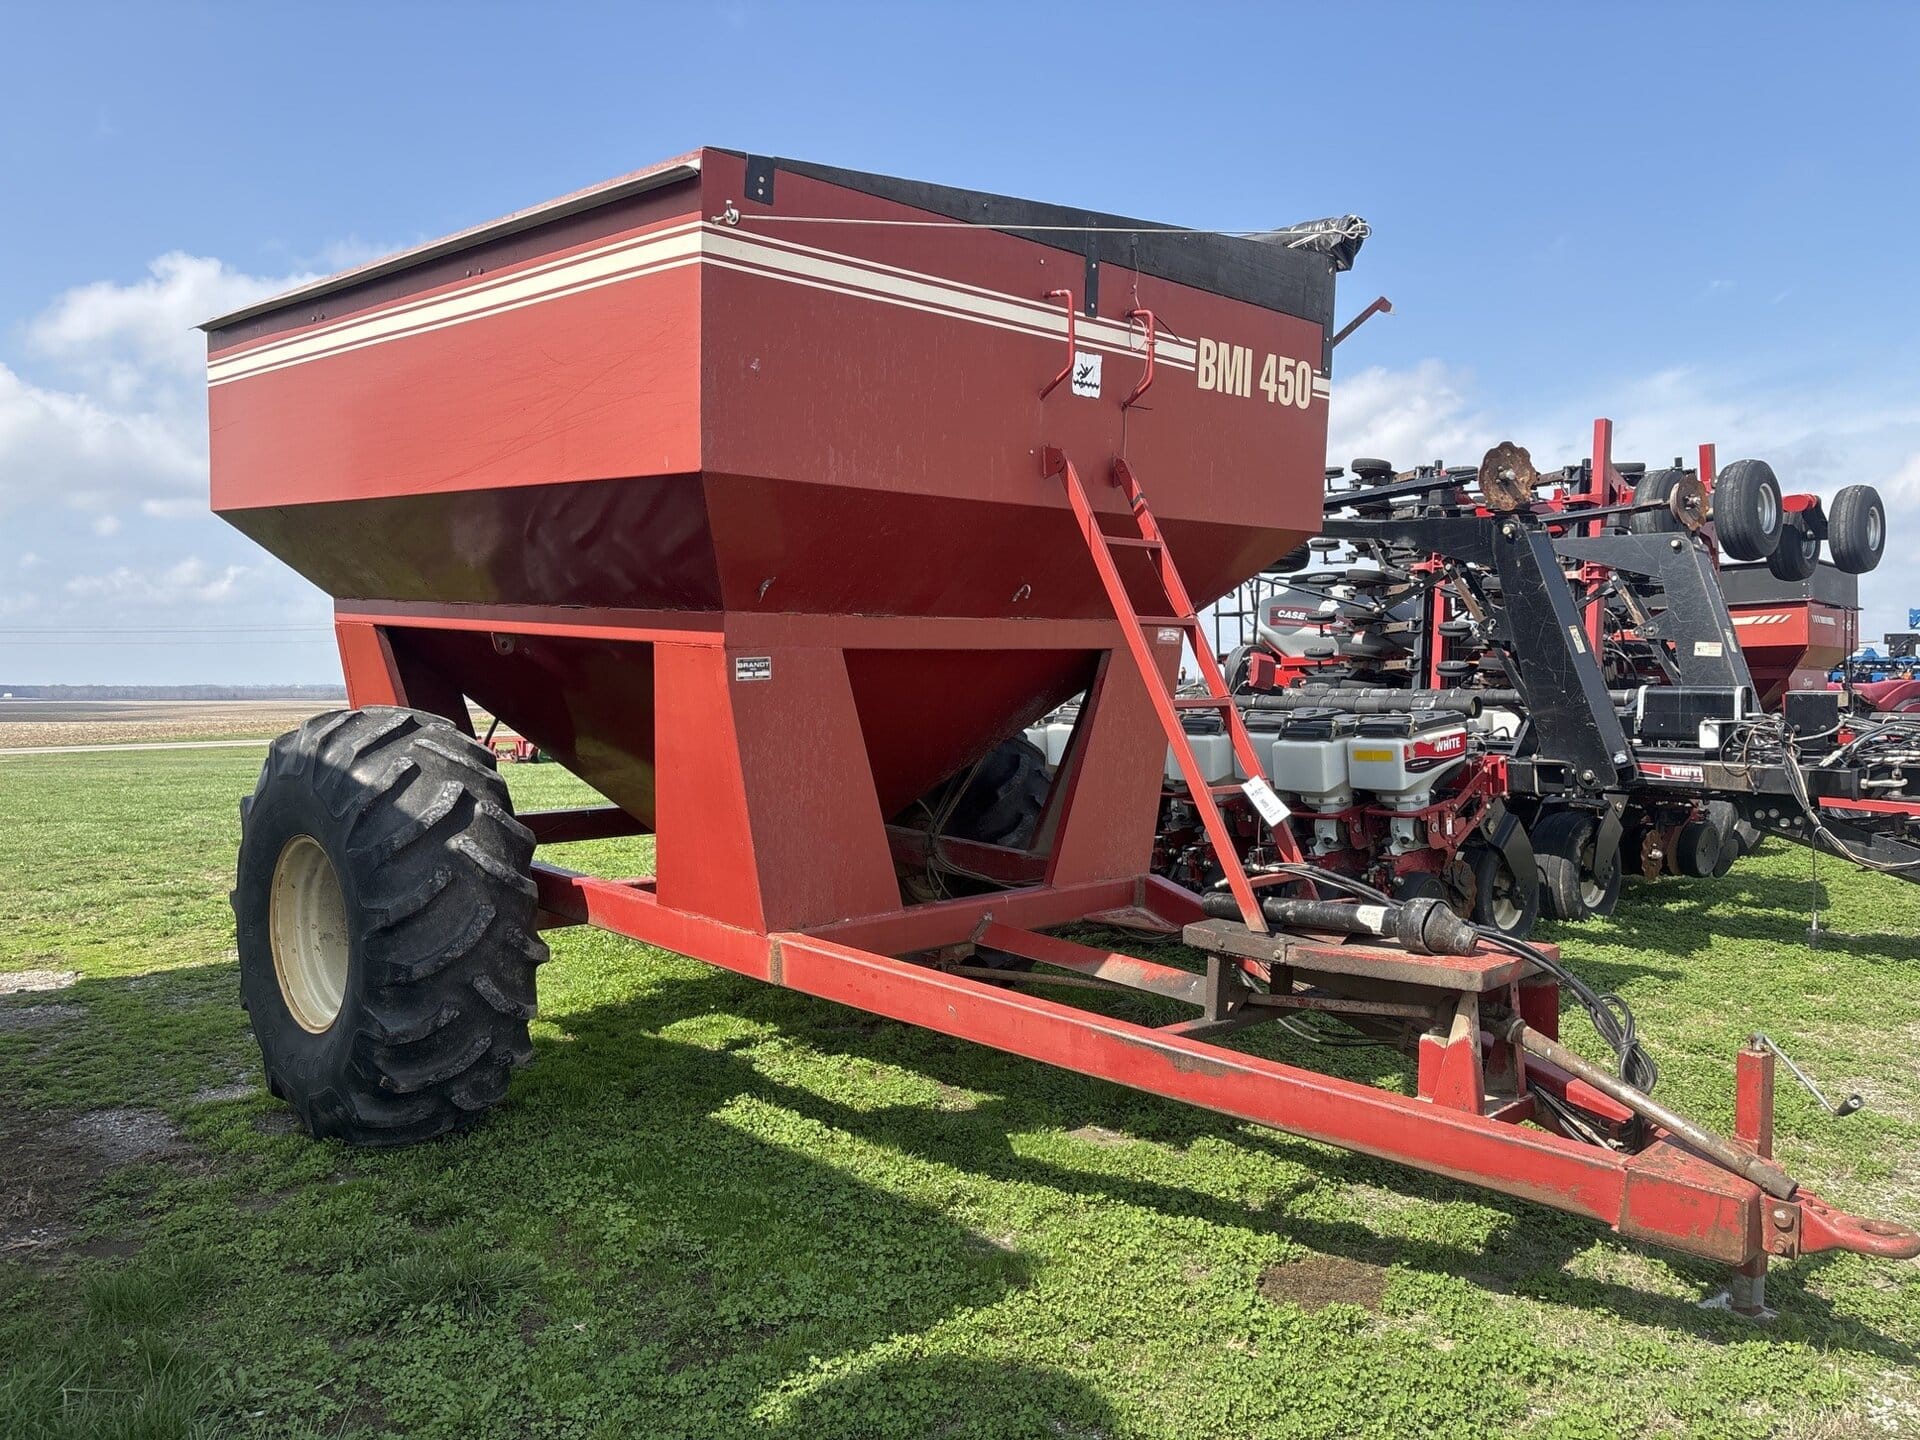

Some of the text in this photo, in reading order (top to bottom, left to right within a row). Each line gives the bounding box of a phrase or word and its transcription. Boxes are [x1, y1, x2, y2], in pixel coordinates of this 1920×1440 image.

[1198, 337, 1312, 410] BMI 450
[1277, 609, 1306, 620] CASE
[1436, 736, 1461, 752] WHITE
